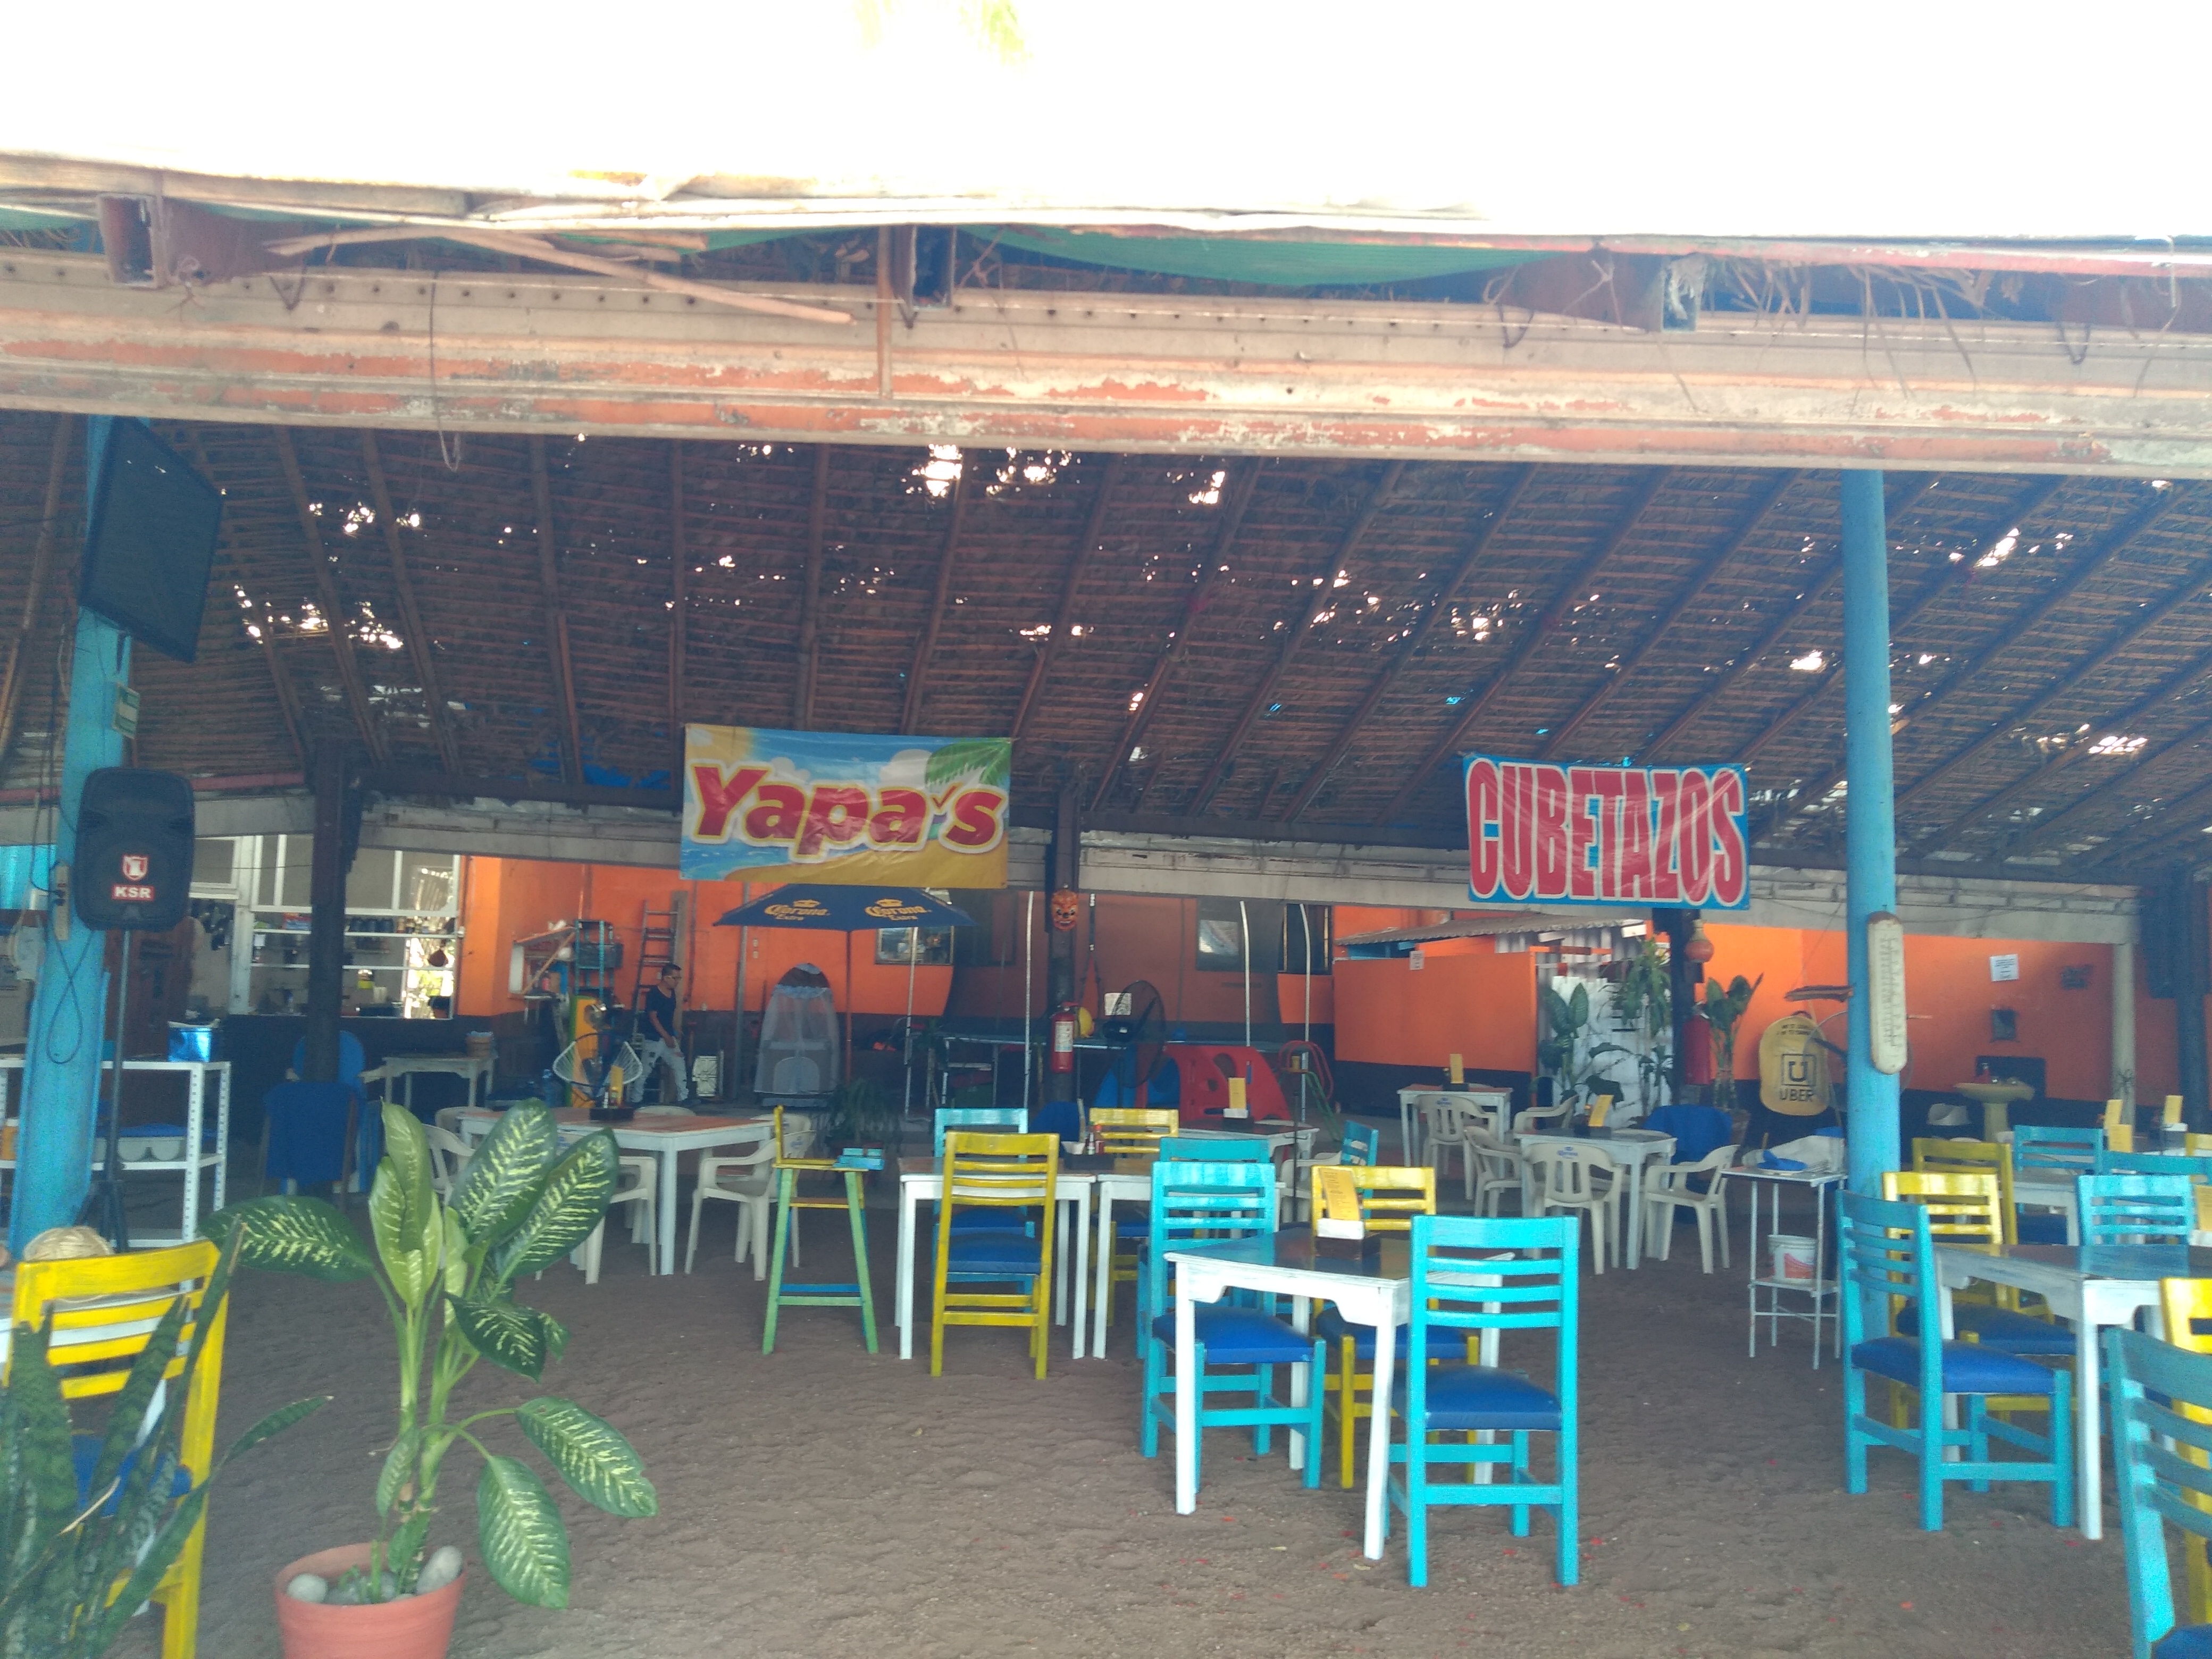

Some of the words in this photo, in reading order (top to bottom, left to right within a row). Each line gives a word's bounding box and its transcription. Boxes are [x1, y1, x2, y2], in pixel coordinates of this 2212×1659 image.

[692, 764, 1005, 858] Yapa's
[1467, 759, 1746, 904] CUBETAZOS
[115, 886, 151, 898] KSR
[1779, 1089, 1814, 1102] UBER
